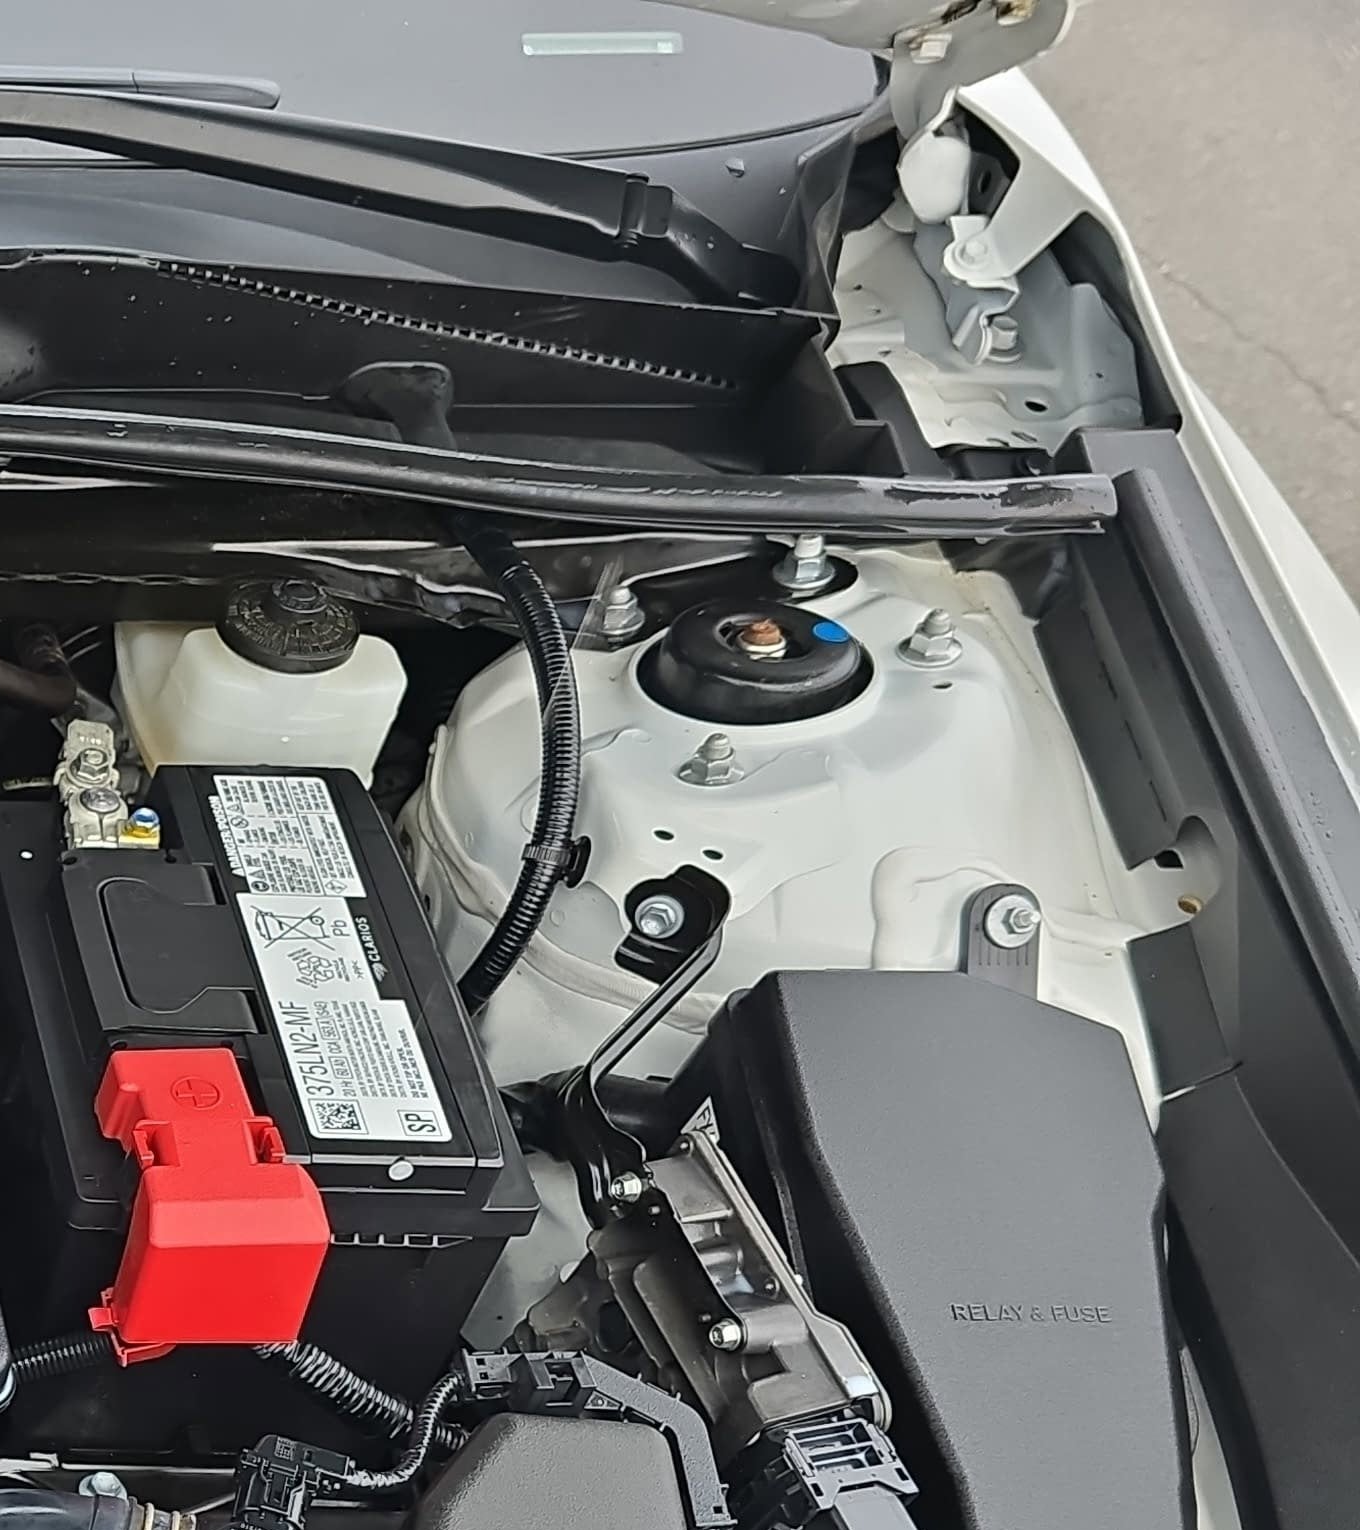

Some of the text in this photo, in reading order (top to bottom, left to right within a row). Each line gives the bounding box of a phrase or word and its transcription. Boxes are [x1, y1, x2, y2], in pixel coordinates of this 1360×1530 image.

[330, 920, 350, 936] Pb
[355, 916, 380, 962] CLARIOS
[278, 1001, 334, 1096] 375LN2-MF
[404, 1113, 436, 1132] SP
[950, 1303, 1112, 1323] RELAY & FUSE
